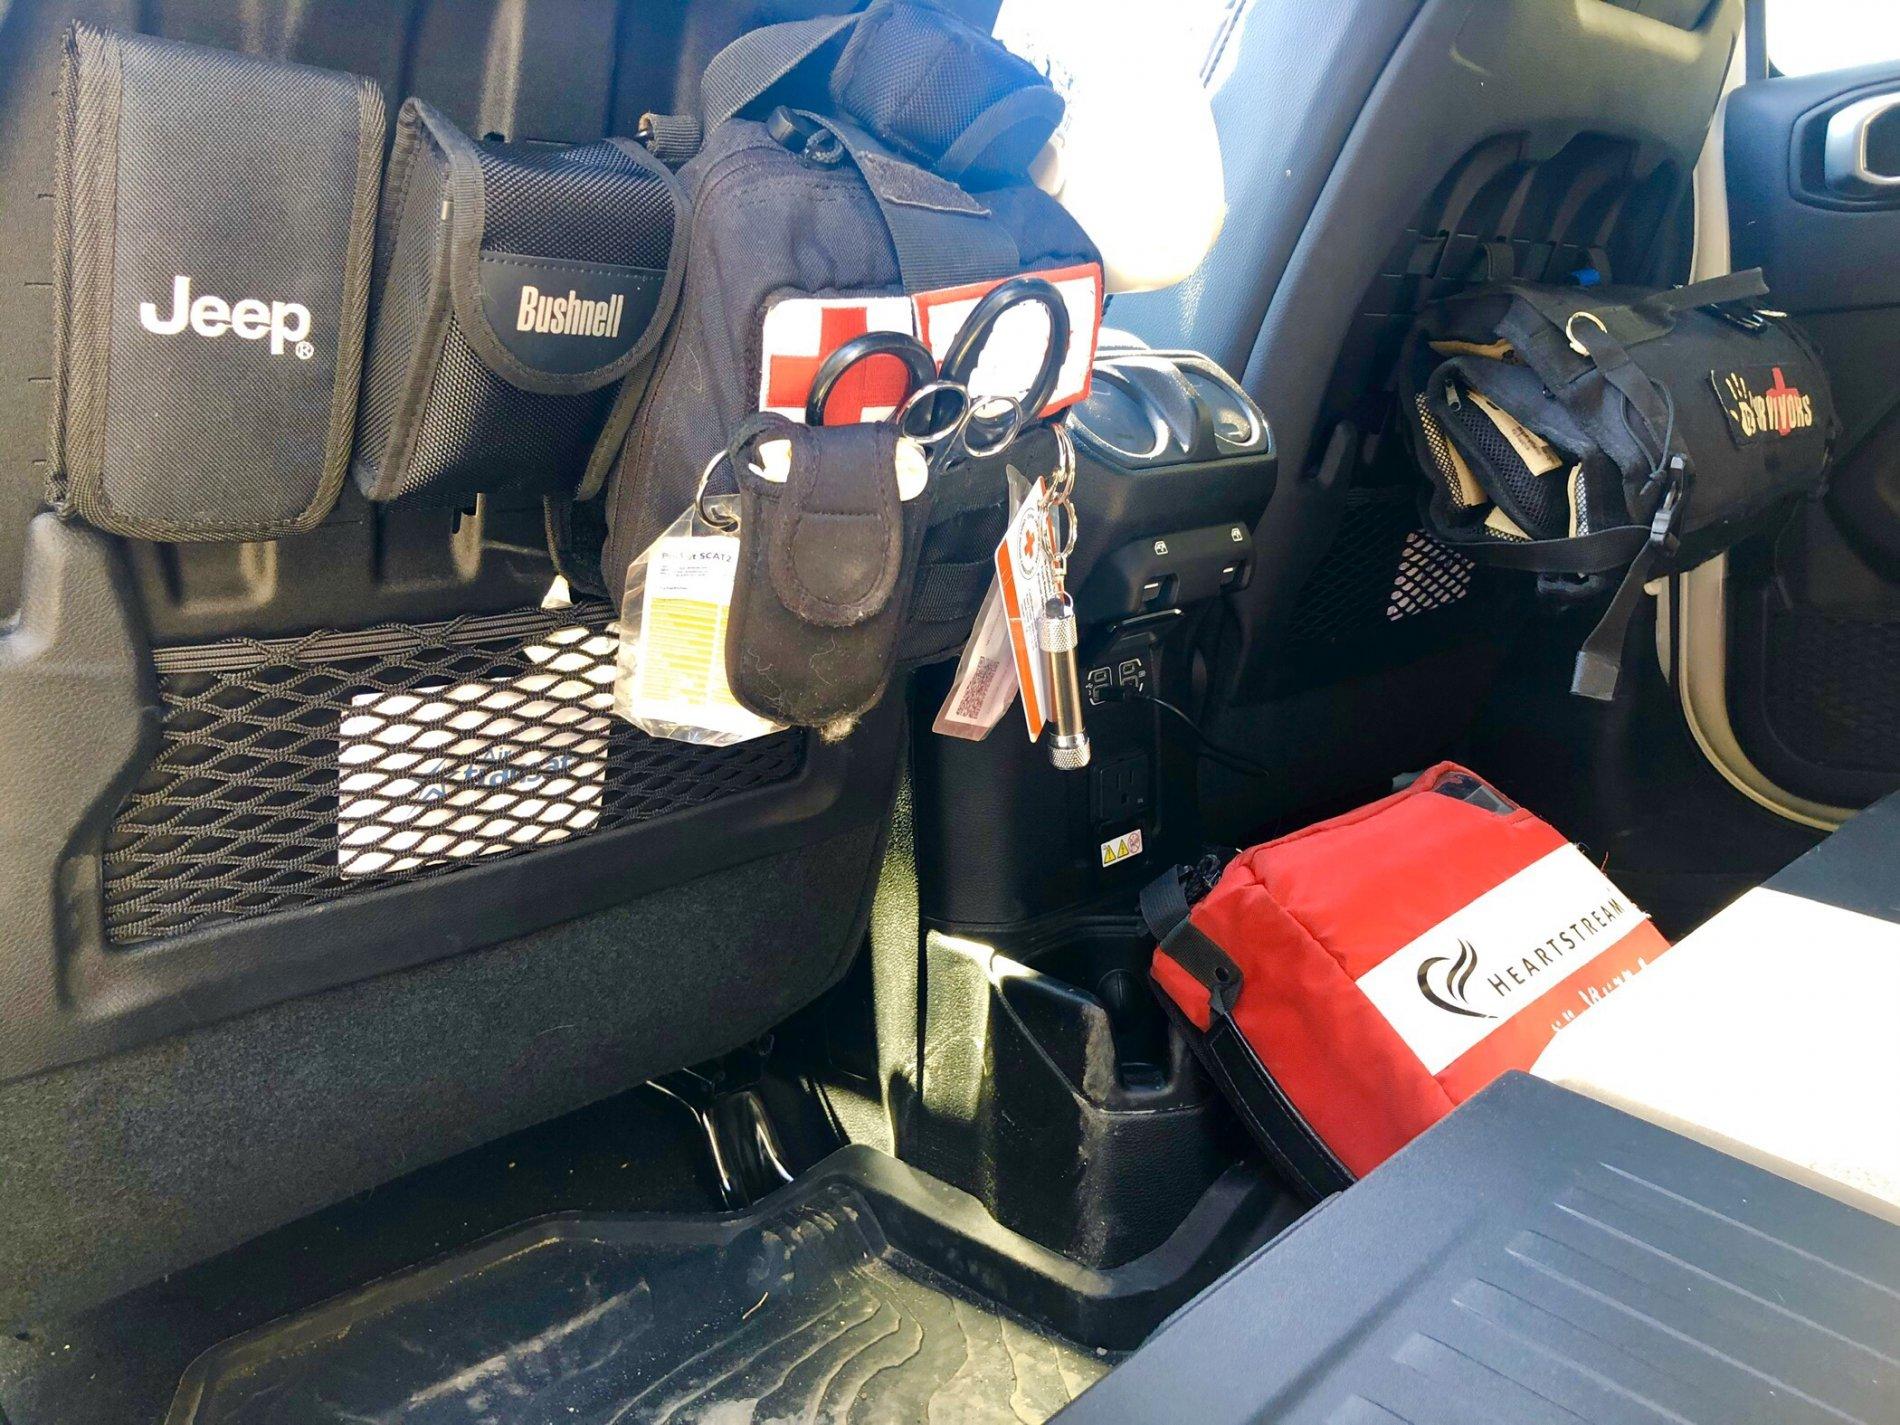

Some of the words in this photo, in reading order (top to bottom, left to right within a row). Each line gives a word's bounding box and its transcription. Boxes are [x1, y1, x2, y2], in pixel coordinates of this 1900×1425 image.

[516, 285, 625, 338] Bushnell
[699, 551, 732, 563] SCAT2
[1486, 897, 1625, 998] HEARTSTREAM
